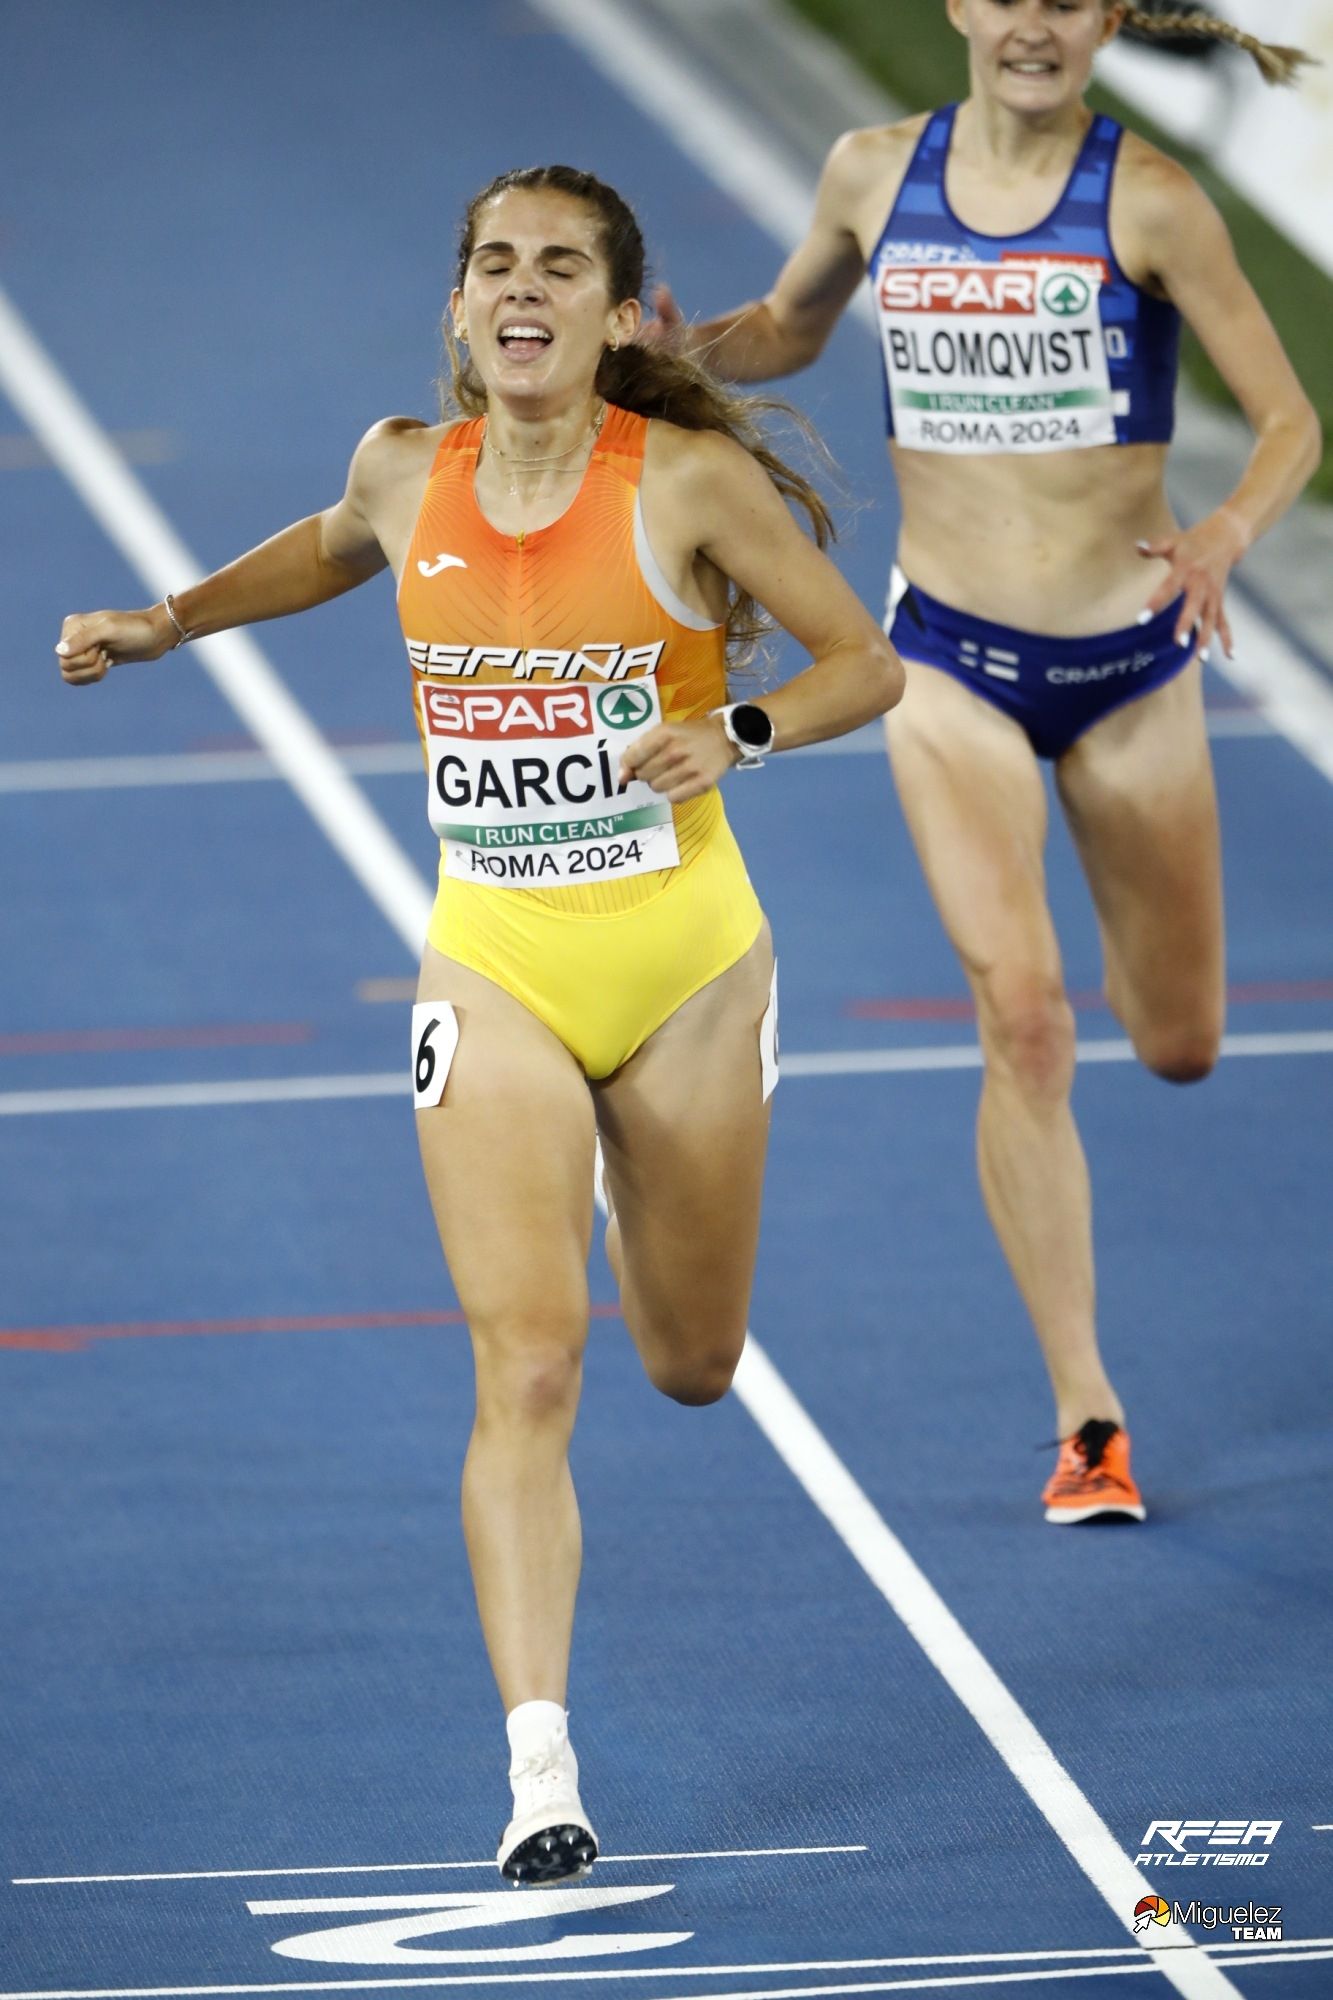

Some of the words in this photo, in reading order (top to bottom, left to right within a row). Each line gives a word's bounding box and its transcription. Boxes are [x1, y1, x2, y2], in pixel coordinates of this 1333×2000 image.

[883, 271, 1034, 311] SPAR
[888, 329, 1092, 379] BLOMQVIST
[920, 419, 1003, 443] ROMA
[1010, 418, 1081, 443] 2024
[405, 639, 666, 681] ESPAÑA
[1045, 659, 1130, 684] CRAFT
[429, 692, 588, 733] SPAR
[476, 828, 481, 845] I
[486, 827, 535, 846] RUN
[471, 849, 560, 879] ROMA
[567, 839, 644, 875] 2024
[415, 1018, 442, 1094] 6
